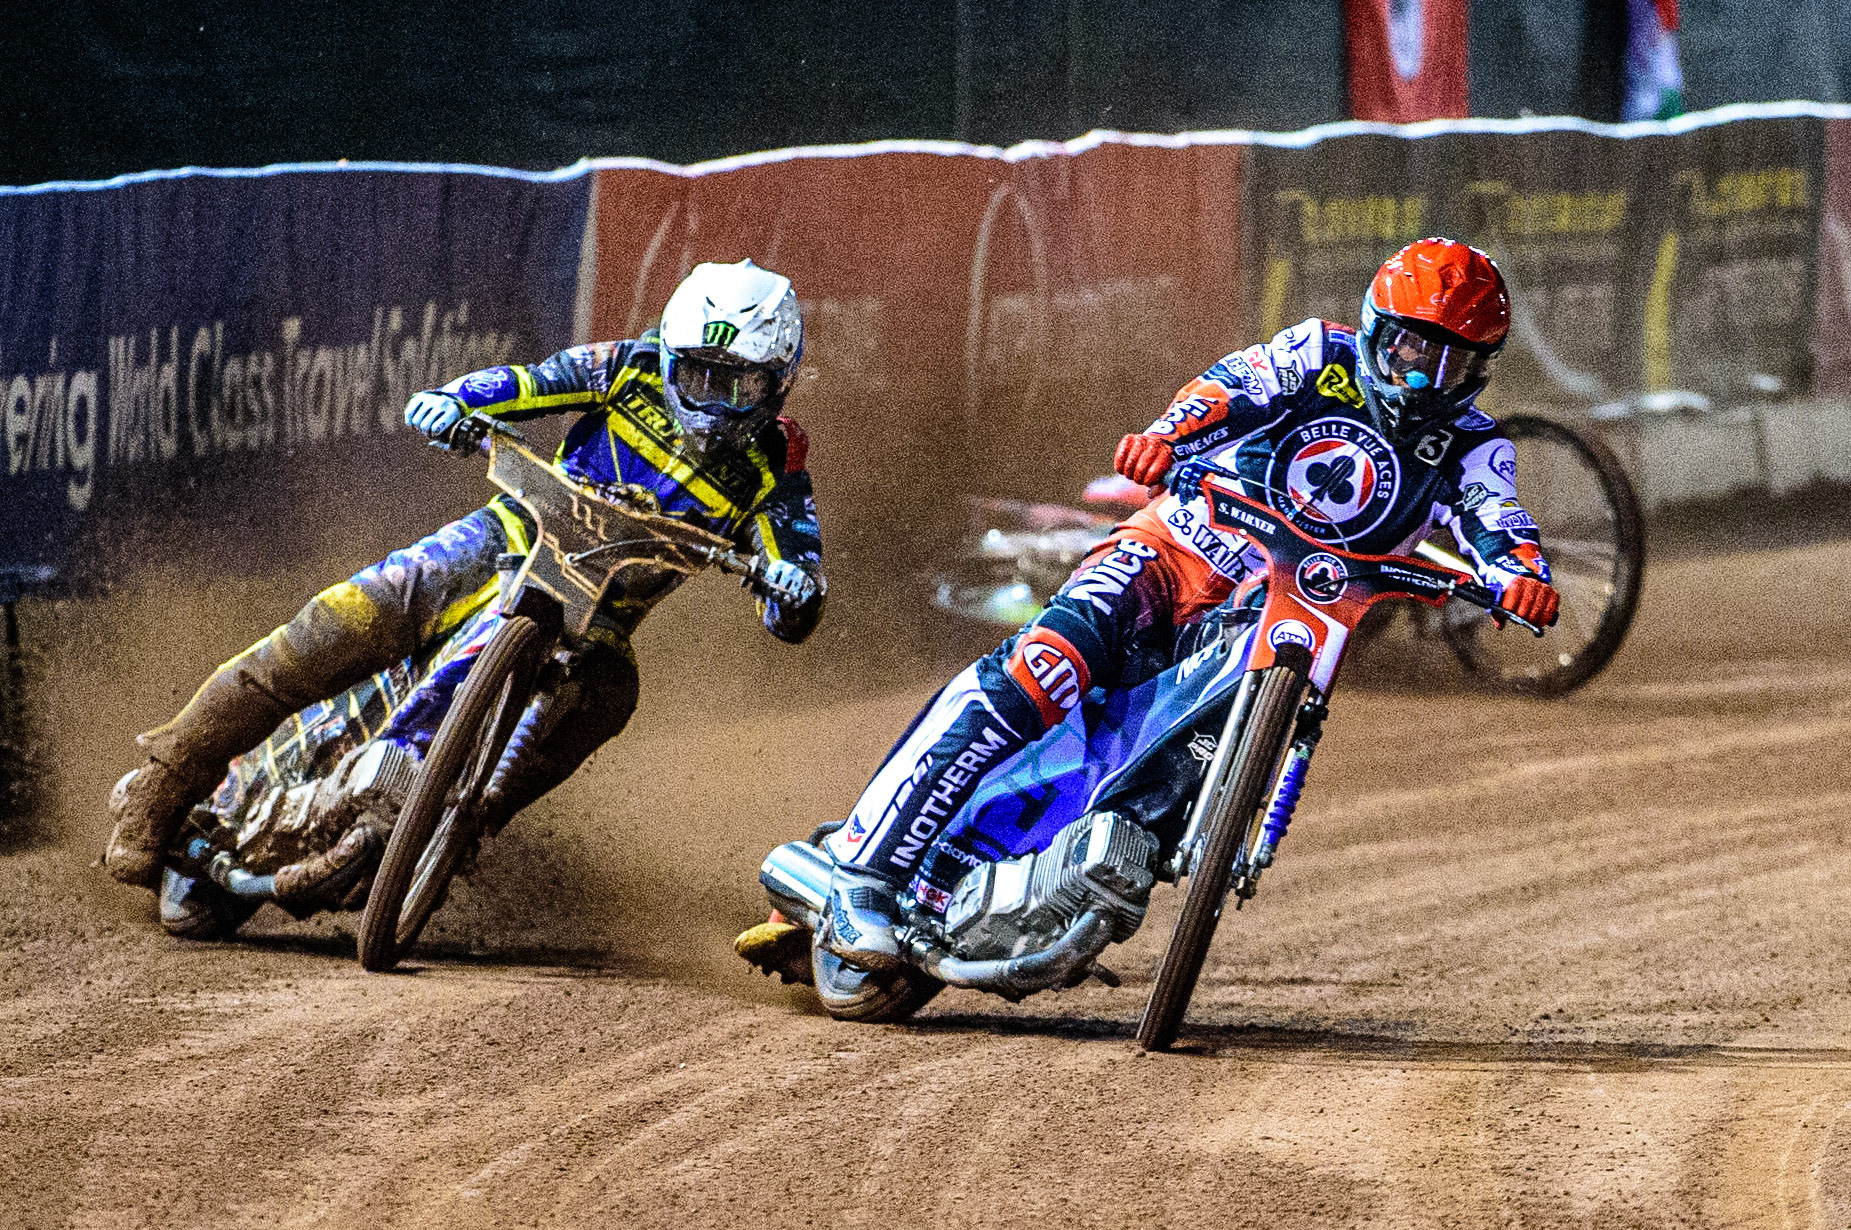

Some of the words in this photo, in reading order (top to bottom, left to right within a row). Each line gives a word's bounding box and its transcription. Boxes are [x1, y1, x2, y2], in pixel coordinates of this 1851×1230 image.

[1300, 424, 1351, 443] BELLE
[1356, 431, 1383, 457] VUE
[1376, 460, 1392, 499] ACES
[1168, 508, 1194, 536] S.
[1230, 506, 1277, 535] WARNER
[889, 726, 1009, 869] INOTHERM
